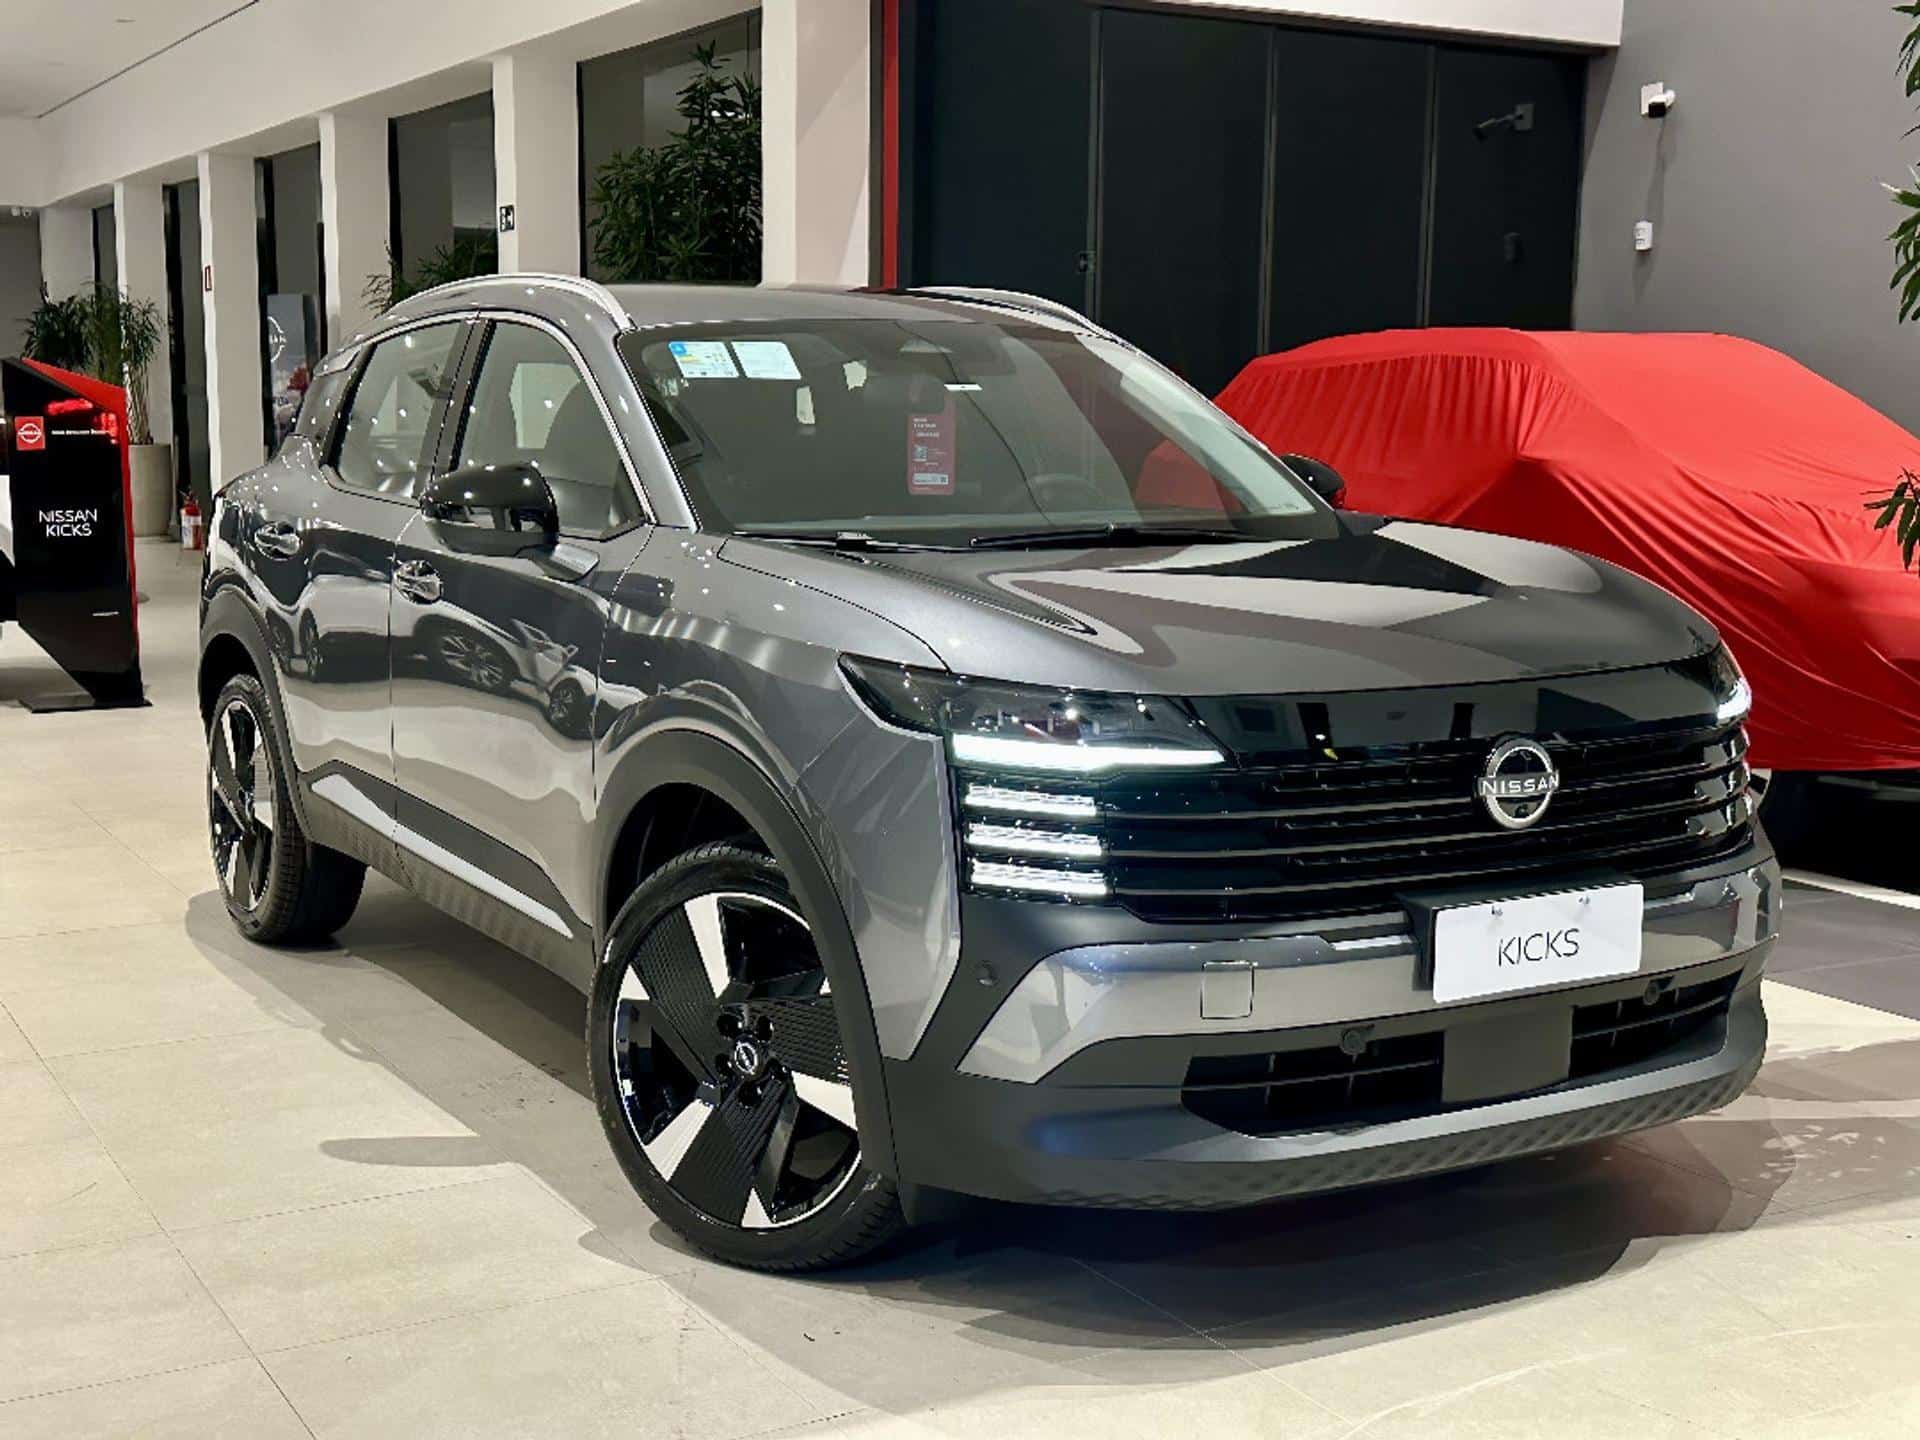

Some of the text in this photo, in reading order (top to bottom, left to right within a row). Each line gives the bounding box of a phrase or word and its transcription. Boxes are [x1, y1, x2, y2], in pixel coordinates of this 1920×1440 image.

[39, 508, 98, 523] NISSAN
[46, 522, 92, 537] KICKS
[1482, 769, 1559, 795] NISSAN
[1498, 928, 1580, 967] KICKS
